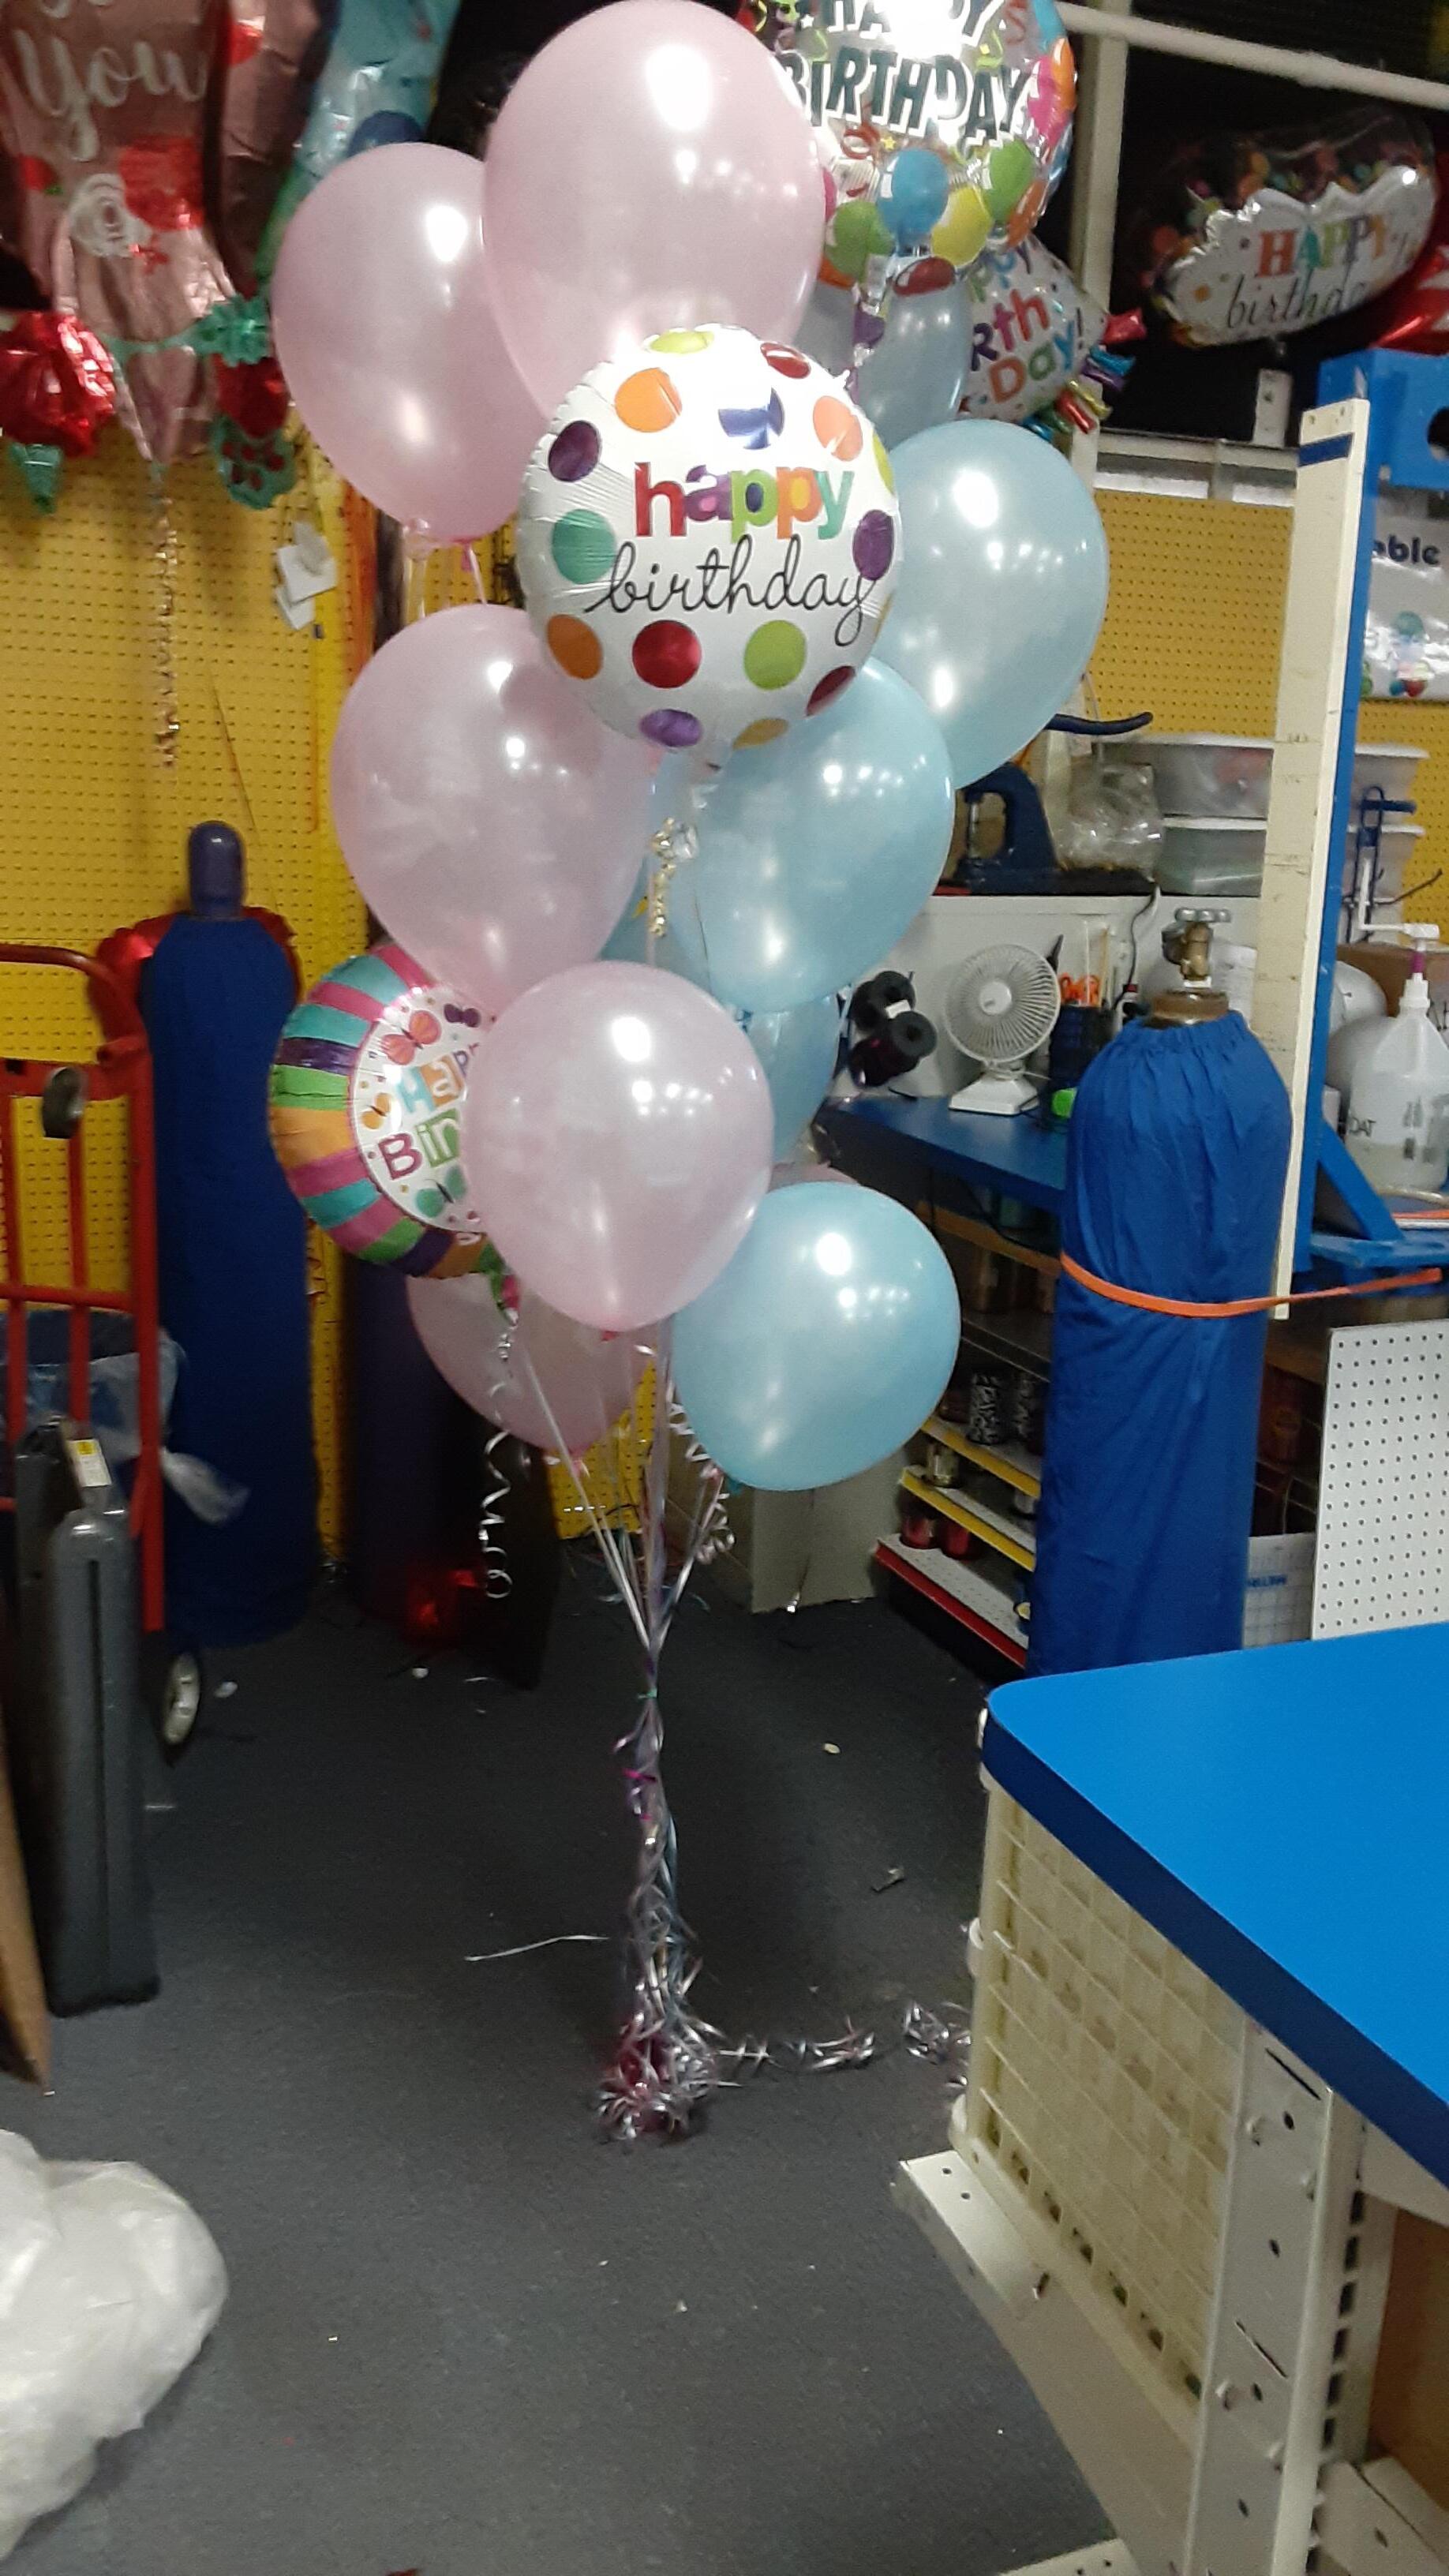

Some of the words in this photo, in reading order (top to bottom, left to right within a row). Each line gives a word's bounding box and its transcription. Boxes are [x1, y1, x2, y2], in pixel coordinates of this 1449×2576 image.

[1257, 214, 1385, 278] HAPPY
[634, 461, 855, 544] happy
[583, 534, 878, 647] birthday
